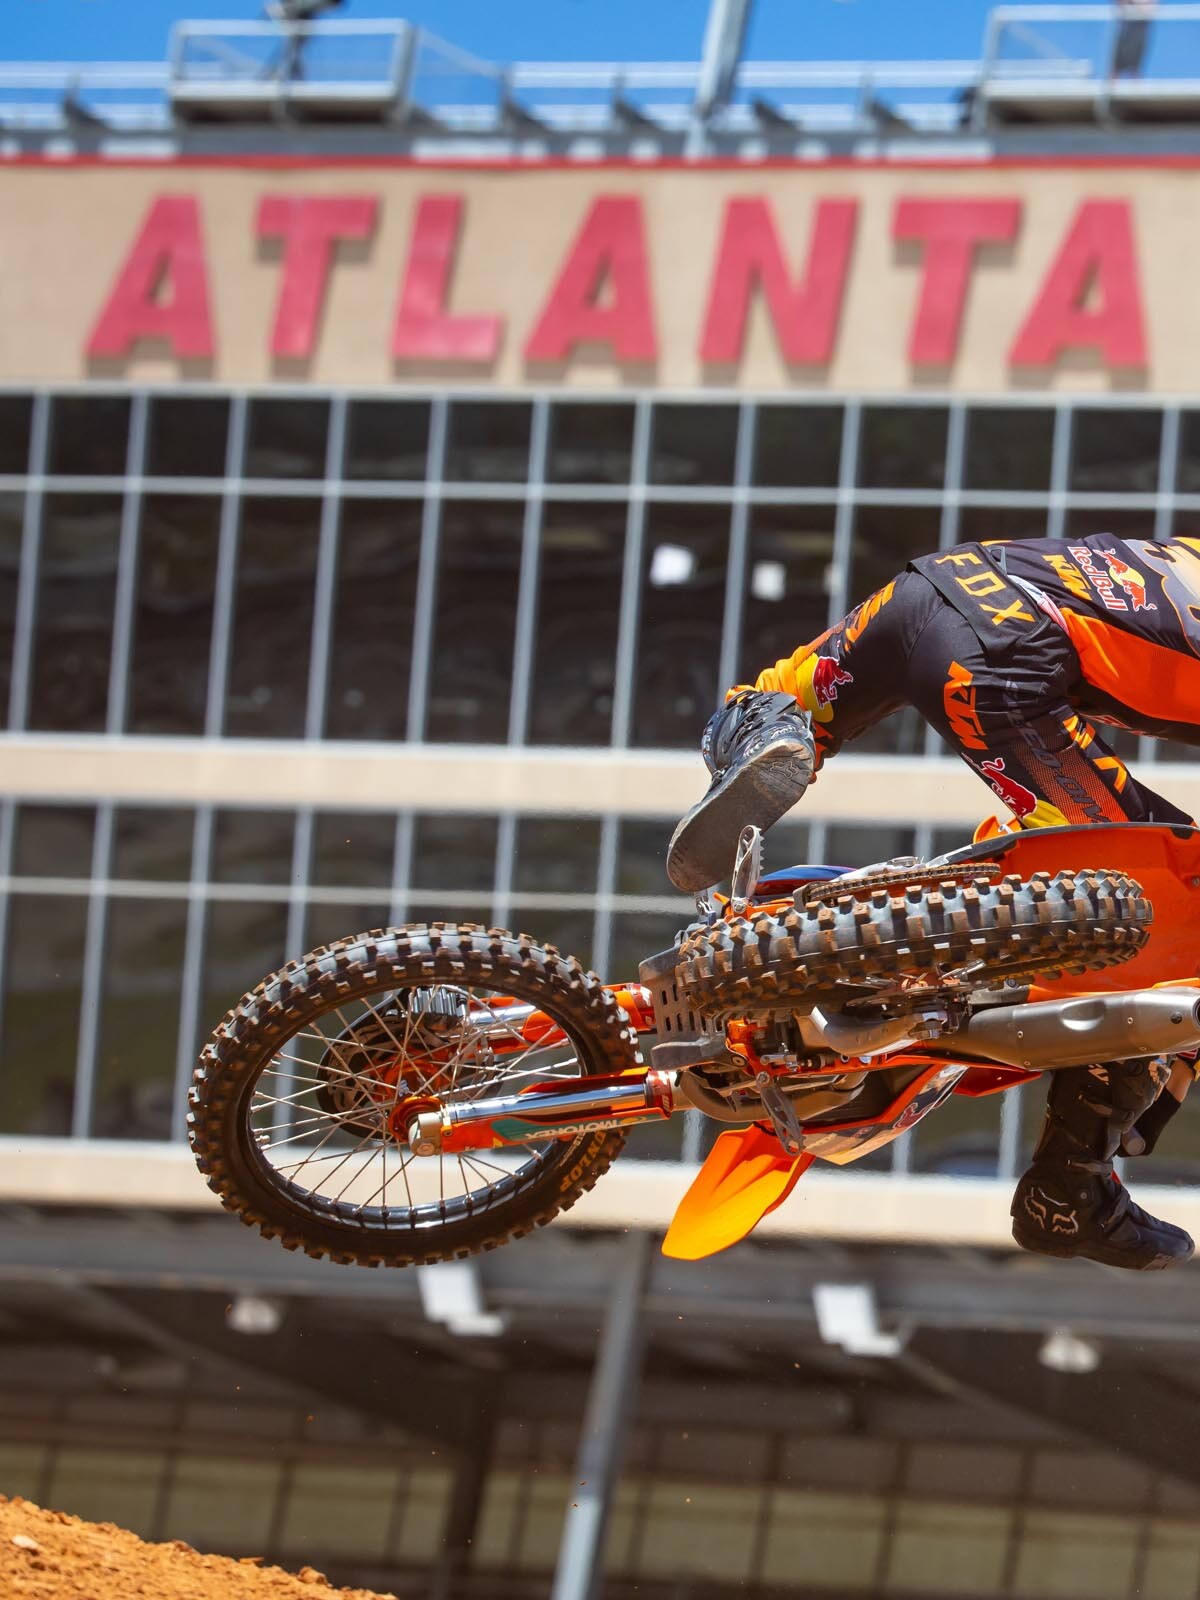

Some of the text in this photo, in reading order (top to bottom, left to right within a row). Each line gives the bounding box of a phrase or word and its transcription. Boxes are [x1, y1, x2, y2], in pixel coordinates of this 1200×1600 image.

[84, 193, 1150, 368] ATLANTA
[934, 552, 1036, 626] FOX
[1042, 554, 1093, 601] KTM
[943, 660, 989, 751] KTM
[524, 1118, 619, 1140] MOTOREX
